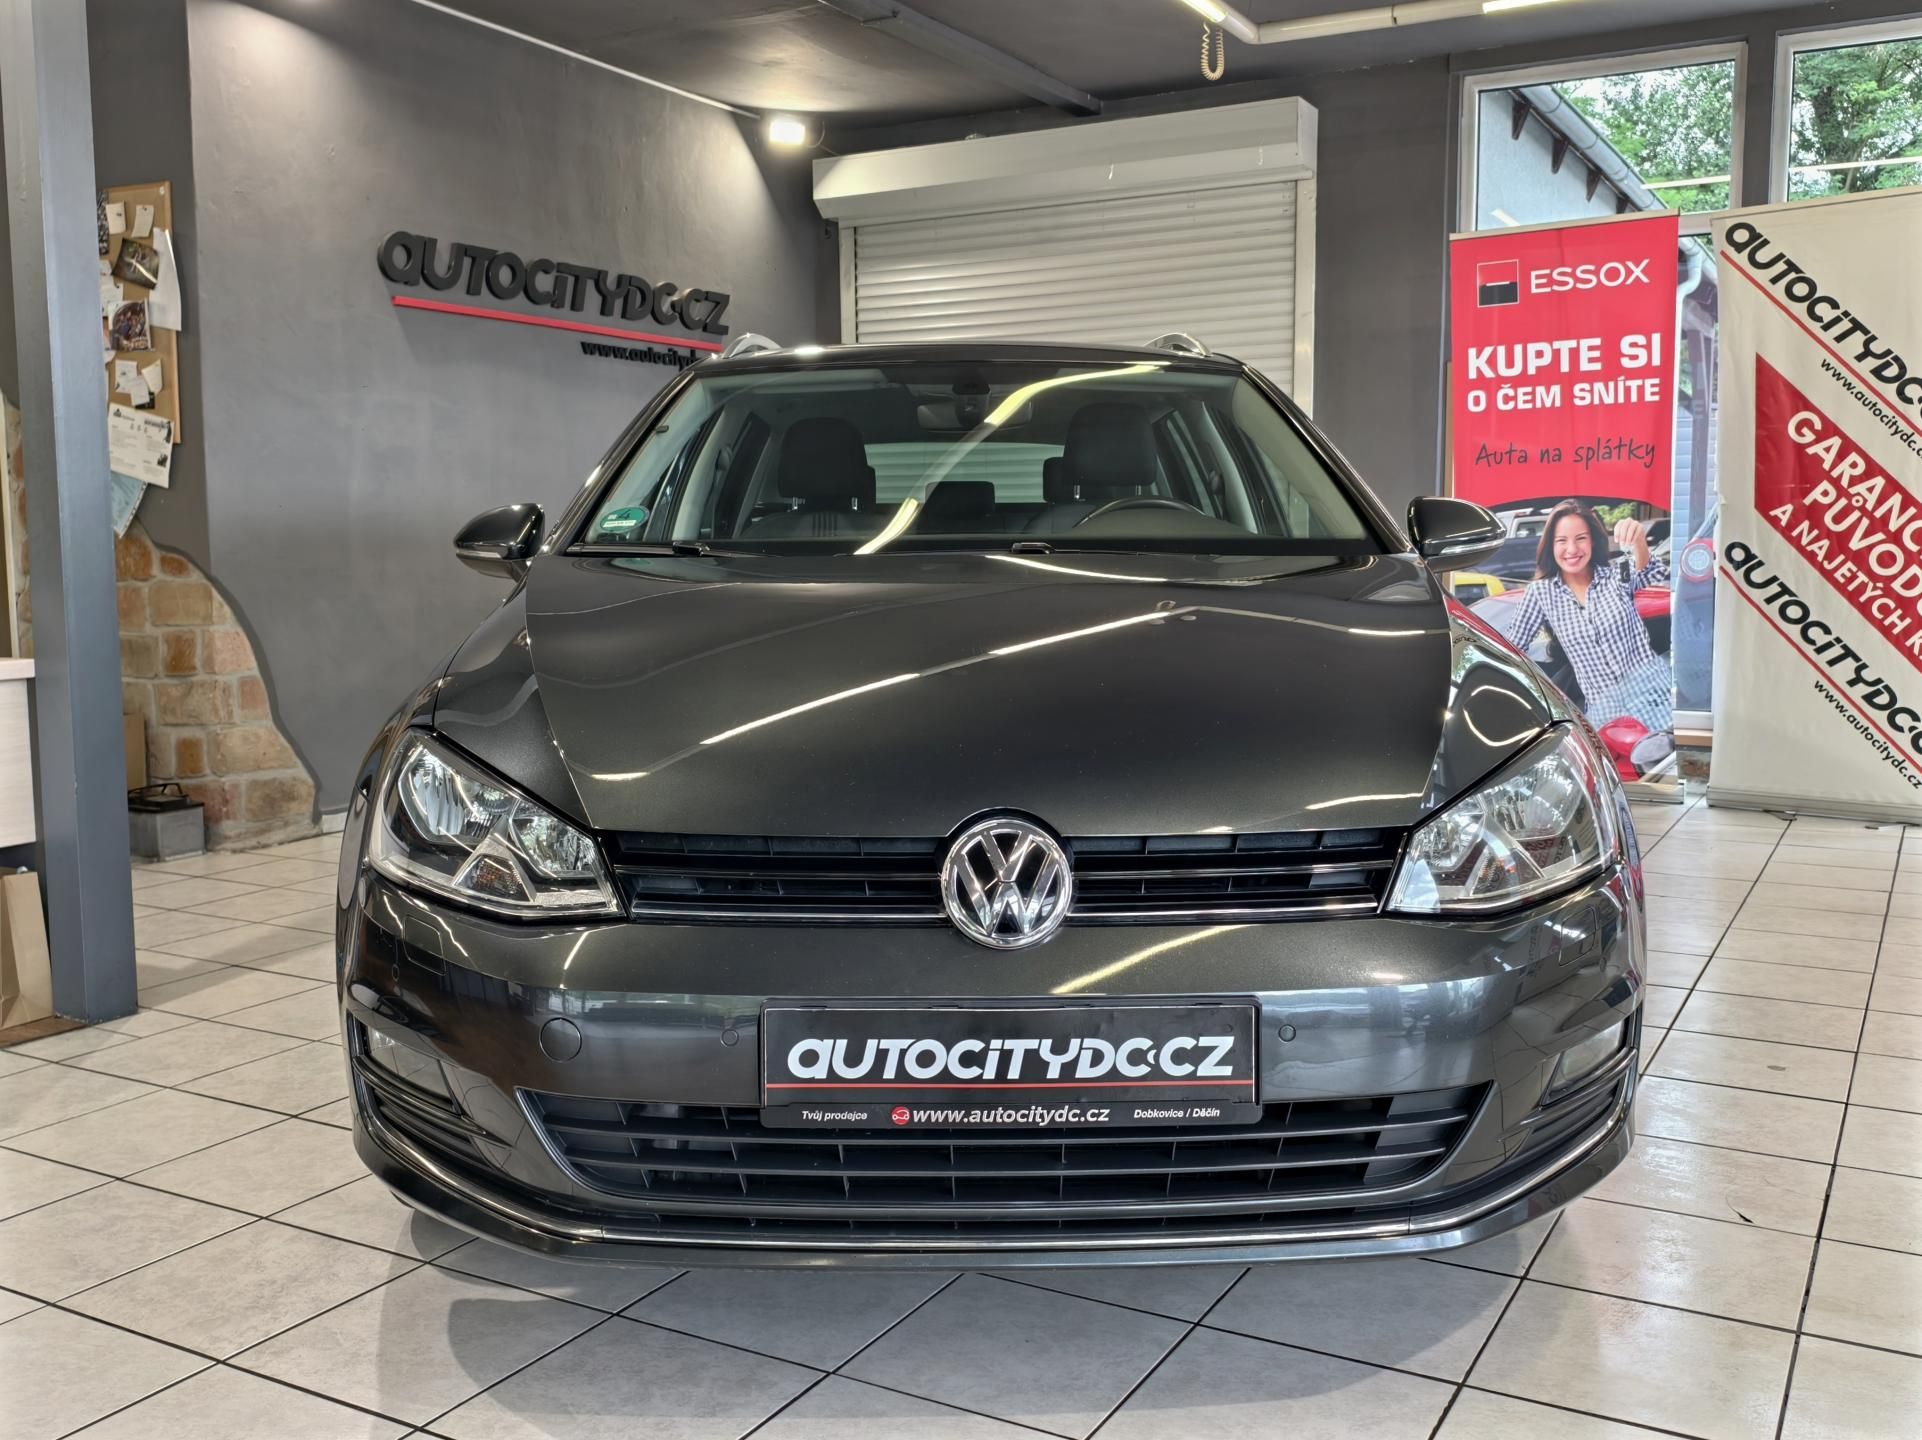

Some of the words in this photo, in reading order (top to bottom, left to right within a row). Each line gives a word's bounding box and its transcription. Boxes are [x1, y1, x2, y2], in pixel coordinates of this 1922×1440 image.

[1530, 259, 1650, 293] ESSOX
[580, 341, 702, 372] www.autocityd
[1467, 338, 1602, 379] KUPTE
[1620, 333, 1661, 369] SI
[1467, 390, 1487, 413] O
[1496, 383, 1561, 411] ČEM
[1573, 376, 1661, 407] SNÍTE
[1820, 358, 1922, 460] www.autocitydc.c
[1475, 442, 1528, 467] Auta
[1540, 447, 1562, 464] na
[1573, 436, 1656, 470] splátky
[1787, 410, 1922, 559] GARANC
[1769, 503, 1794, 527] A
[1791, 520, 1912, 635] NAJETÝCH
[1803, 480, 1922, 617] PŮVOD
[1814, 680, 1922, 789] www.autocitydc.cz
[801, 1110, 823, 1121] Tvůj
[824, 1110, 868, 1121] prodejce
[913, 1105, 1110, 1124] www.autocitydc.cz
[1133, 1108, 1184, 1119] Dobkovice
[1192, 1107, 1221, 1118] Děčín
